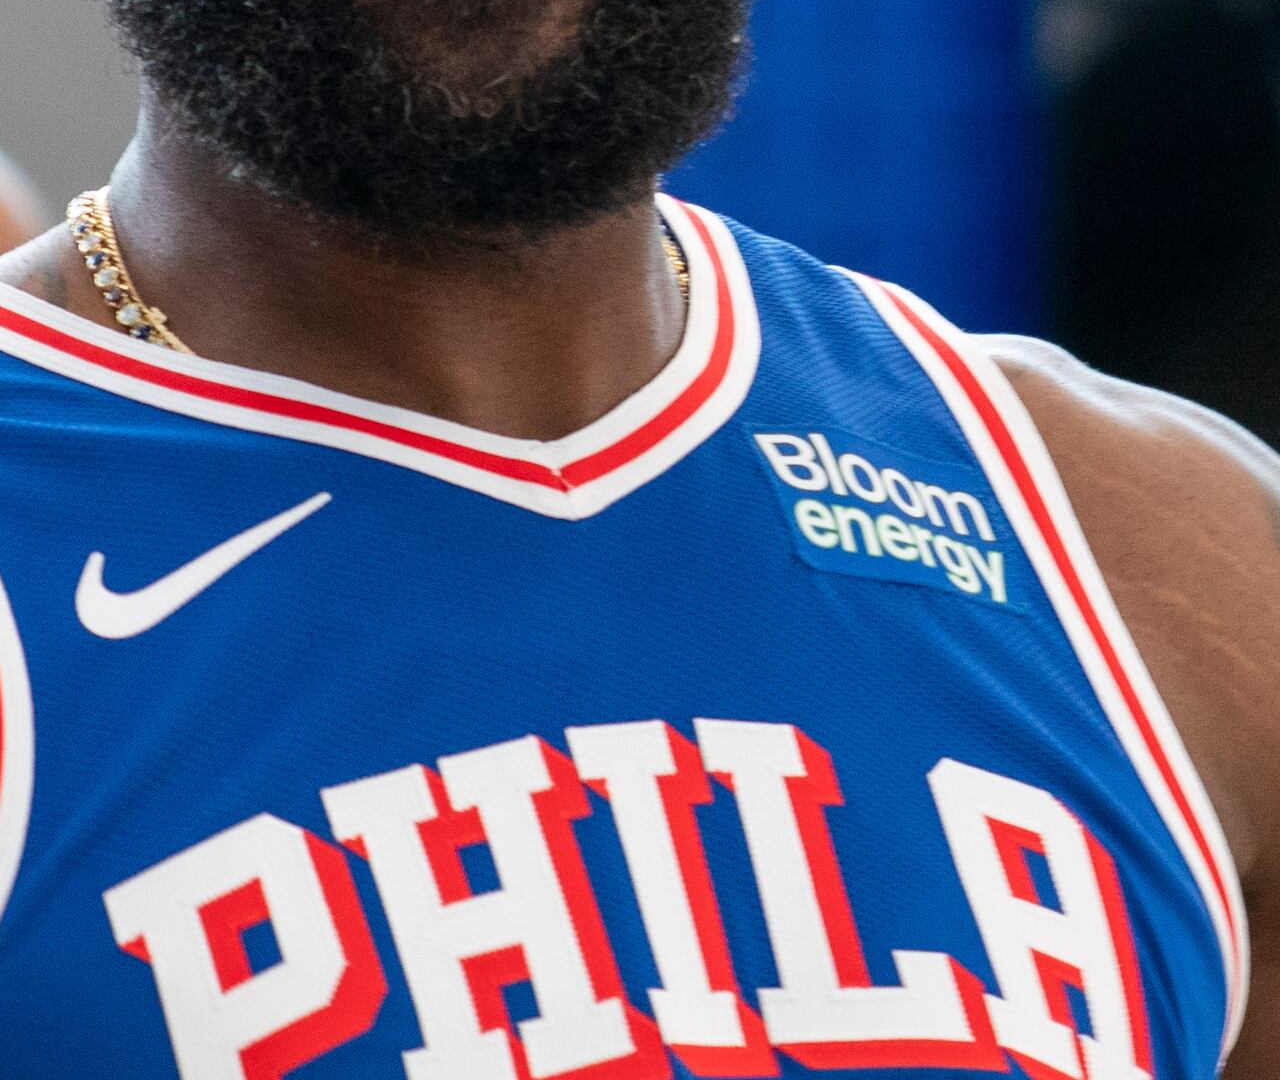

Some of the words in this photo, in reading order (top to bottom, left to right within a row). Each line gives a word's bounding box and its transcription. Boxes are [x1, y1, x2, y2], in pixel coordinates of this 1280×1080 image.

[753, 433, 996, 542] Bloom
[793, 498, 1007, 604] energy
[102, 717, 1156, 1080] PHILA
